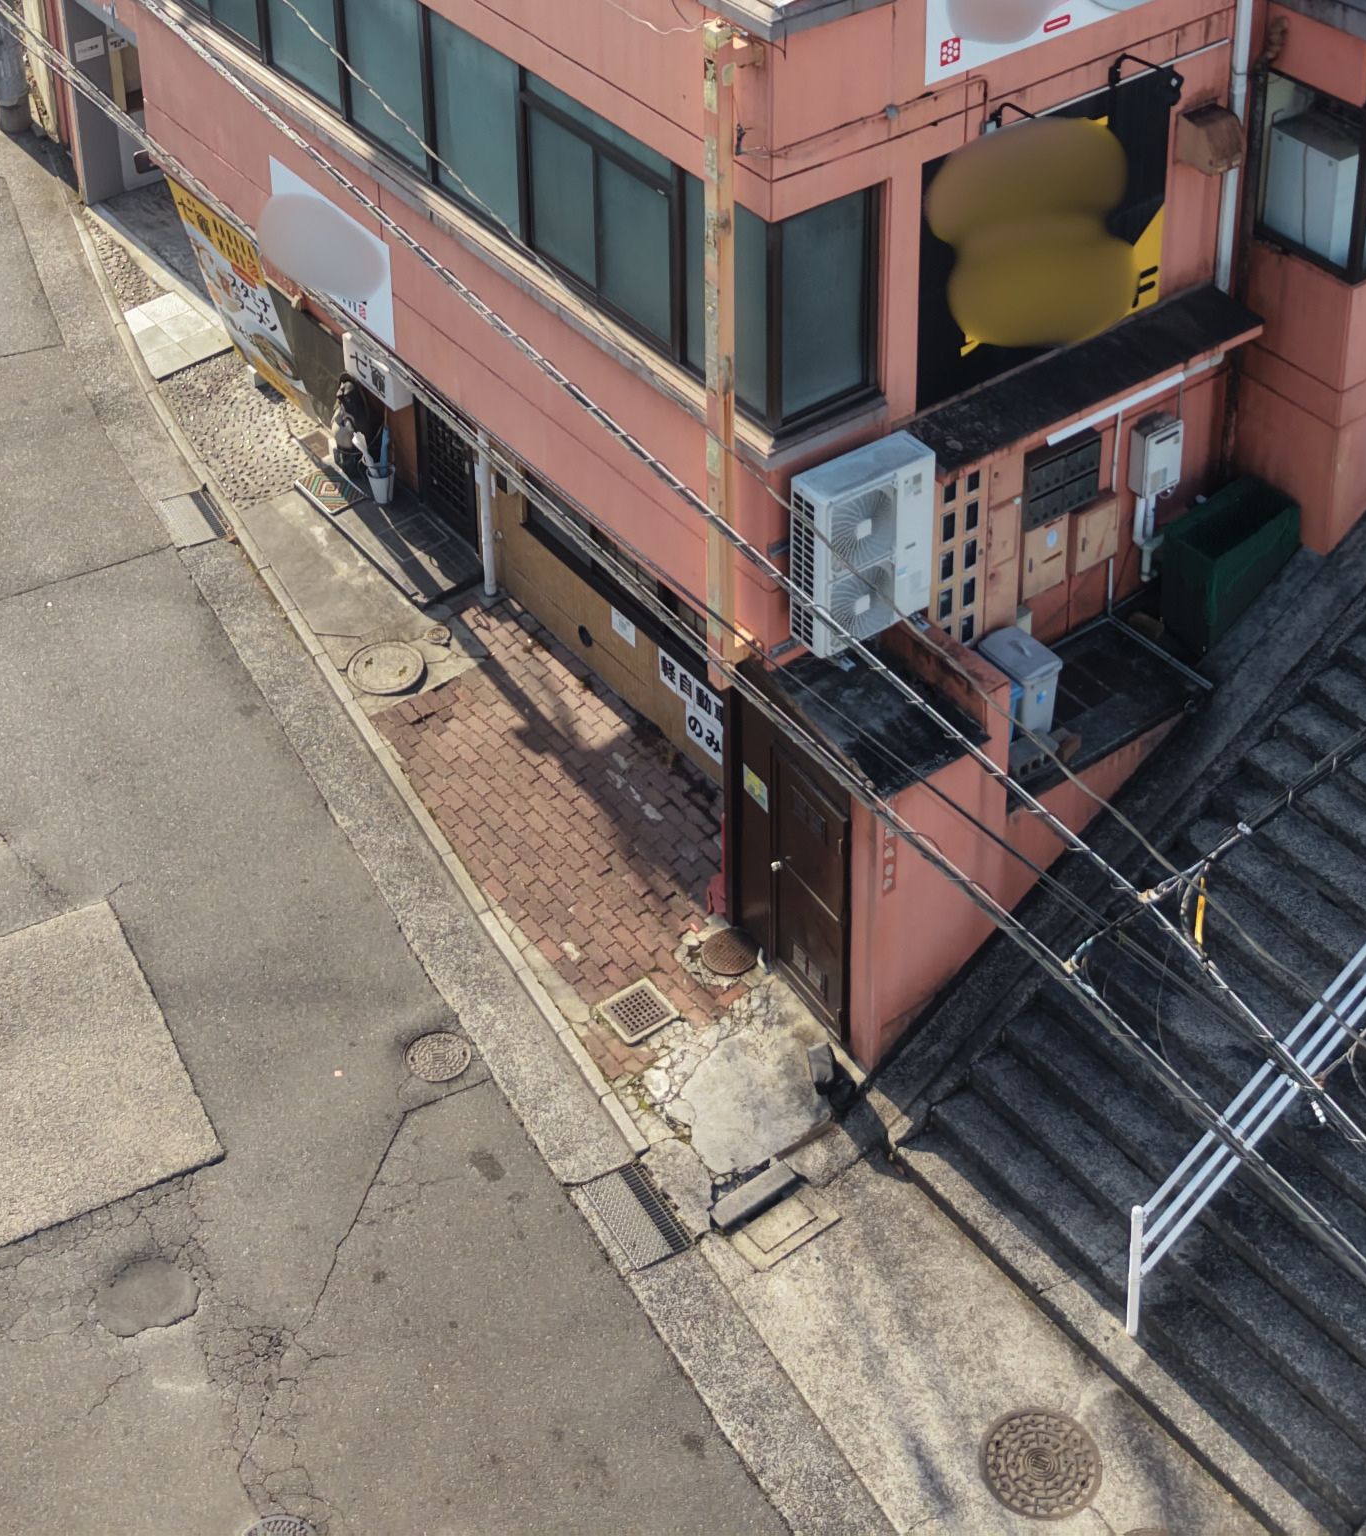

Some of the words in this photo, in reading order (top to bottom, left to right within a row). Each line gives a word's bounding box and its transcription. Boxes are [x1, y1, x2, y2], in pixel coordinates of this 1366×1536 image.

[227, 272, 271, 313] スタミナ
[233, 288, 278, 332] ラーメン
[687, 714, 724, 755] のみ
